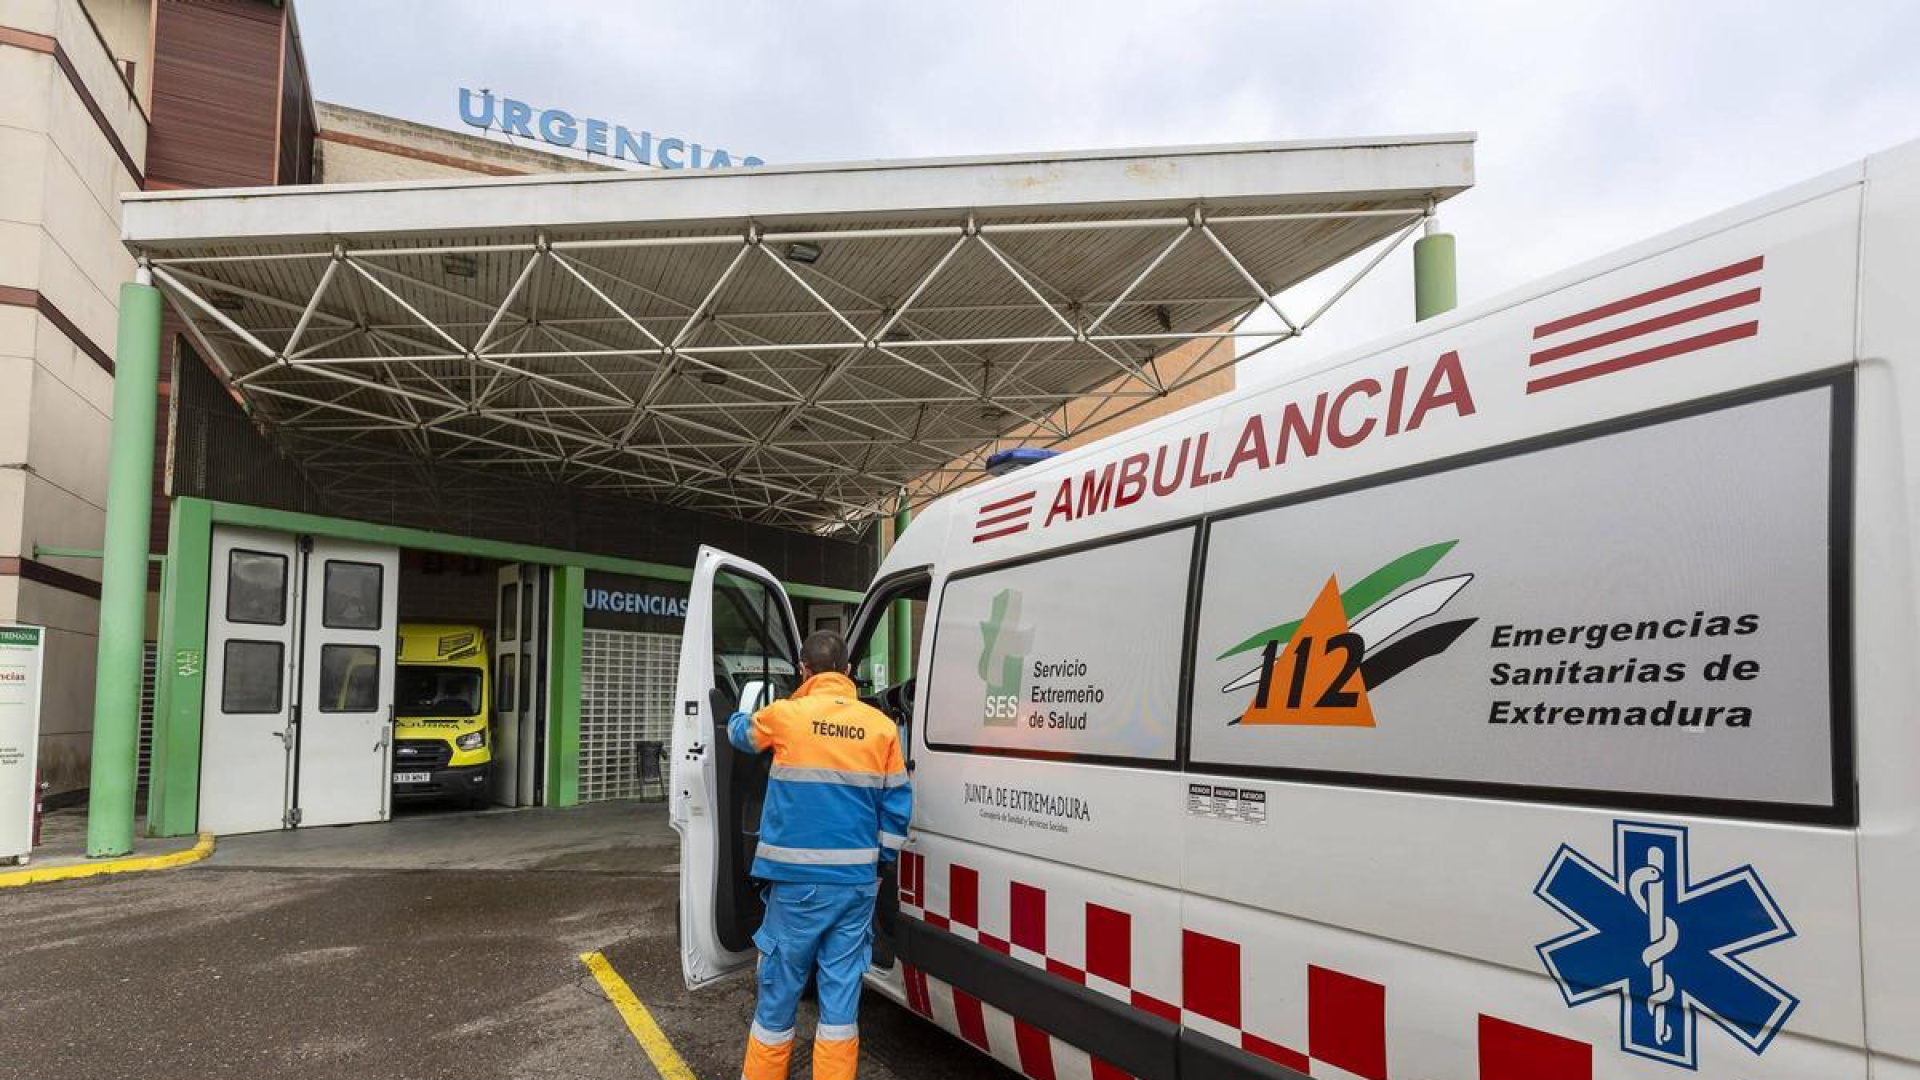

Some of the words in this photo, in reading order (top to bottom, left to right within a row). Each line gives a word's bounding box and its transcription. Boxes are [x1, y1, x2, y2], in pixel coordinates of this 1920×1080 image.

[458, 87, 766, 170] URGENCIA
[1043, 349, 1477, 528] AMBULANCIA
[583, 588, 689, 617] URGENCIAS
[1490, 610, 1760, 650] Emergencias
[1033, 658, 1087, 678] Servicio
[1254, 632, 1366, 710] 112
[1489, 657, 1687, 686] Sanitarias
[1702, 653, 1761, 682] de
[985, 695, 1019, 718] SES
[1031, 684, 1105, 703] Extremeño
[1028, 711, 1044, 729] de
[1047, 711, 1088, 730] Salud
[1487, 699, 1753, 728] Extremadura
[812, 719, 865, 740] TÉCNICO
[964, 782, 994, 806] JUNTA
[996, 786, 1008, 808] DE
[1010, 789, 1091, 822] EXTREMADURA
